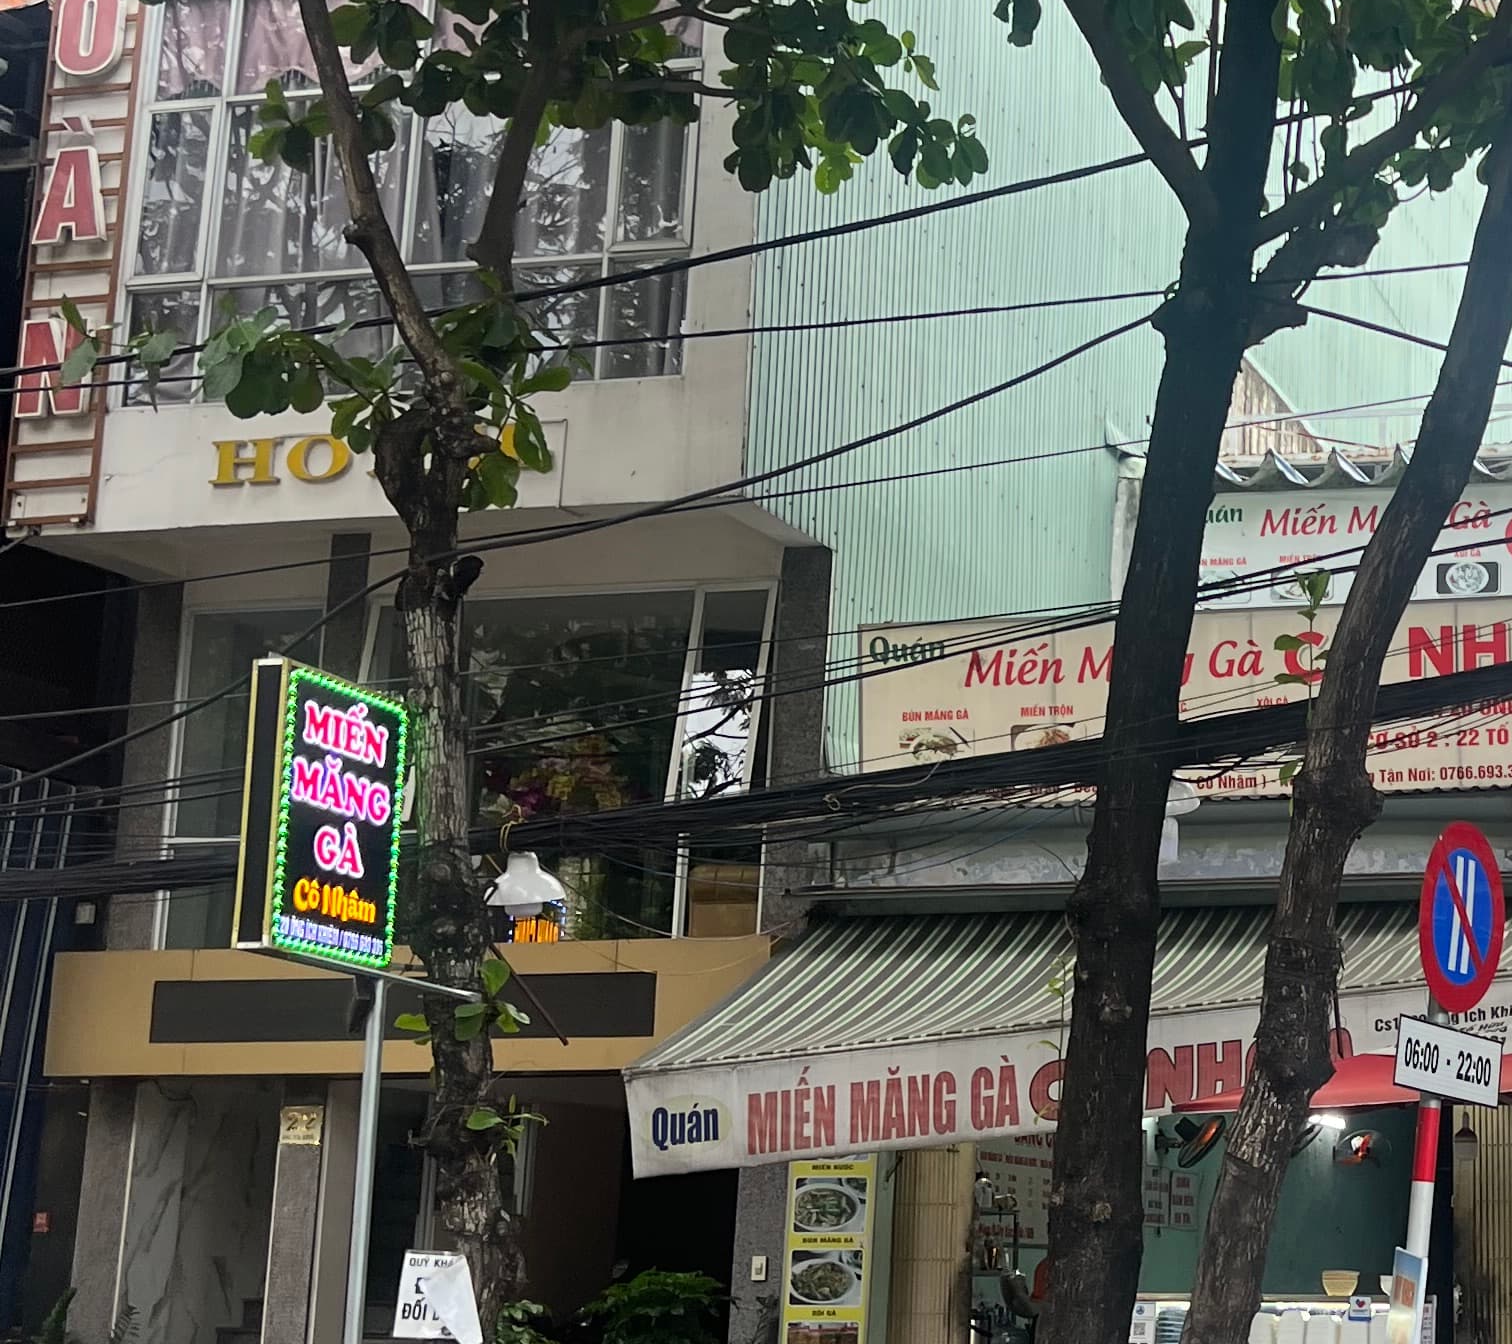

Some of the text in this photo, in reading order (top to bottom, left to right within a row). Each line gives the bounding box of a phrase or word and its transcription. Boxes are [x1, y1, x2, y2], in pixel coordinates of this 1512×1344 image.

[1260, 503, 1338, 537] Miến
[1449, 500, 1493, 530] Gà
[869, 635, 945, 665] Quán
[964, 642, 1065, 688] Miến
[1208, 639, 1264, 679] Gà
[304, 701, 388, 768] MIẾN
[1456, 730, 1480, 747] 22
[1486, 722, 1509, 745] TỐ
[292, 754, 390, 825] MĂNG
[1218, 772, 1257, 789] Nhâm
[1381, 769, 1403, 785] Tận
[1408, 767, 1435, 783] Nơi:
[314, 821, 364, 878] GÀ
[293, 877, 376, 923] Cô Nhâm
[1405, 1037, 1439, 1074] 06:00
[1456, 1050, 1491, 1087] 22:00
[652, 1055, 1020, 1155] Quán MIẾN MĂNG GÀ
